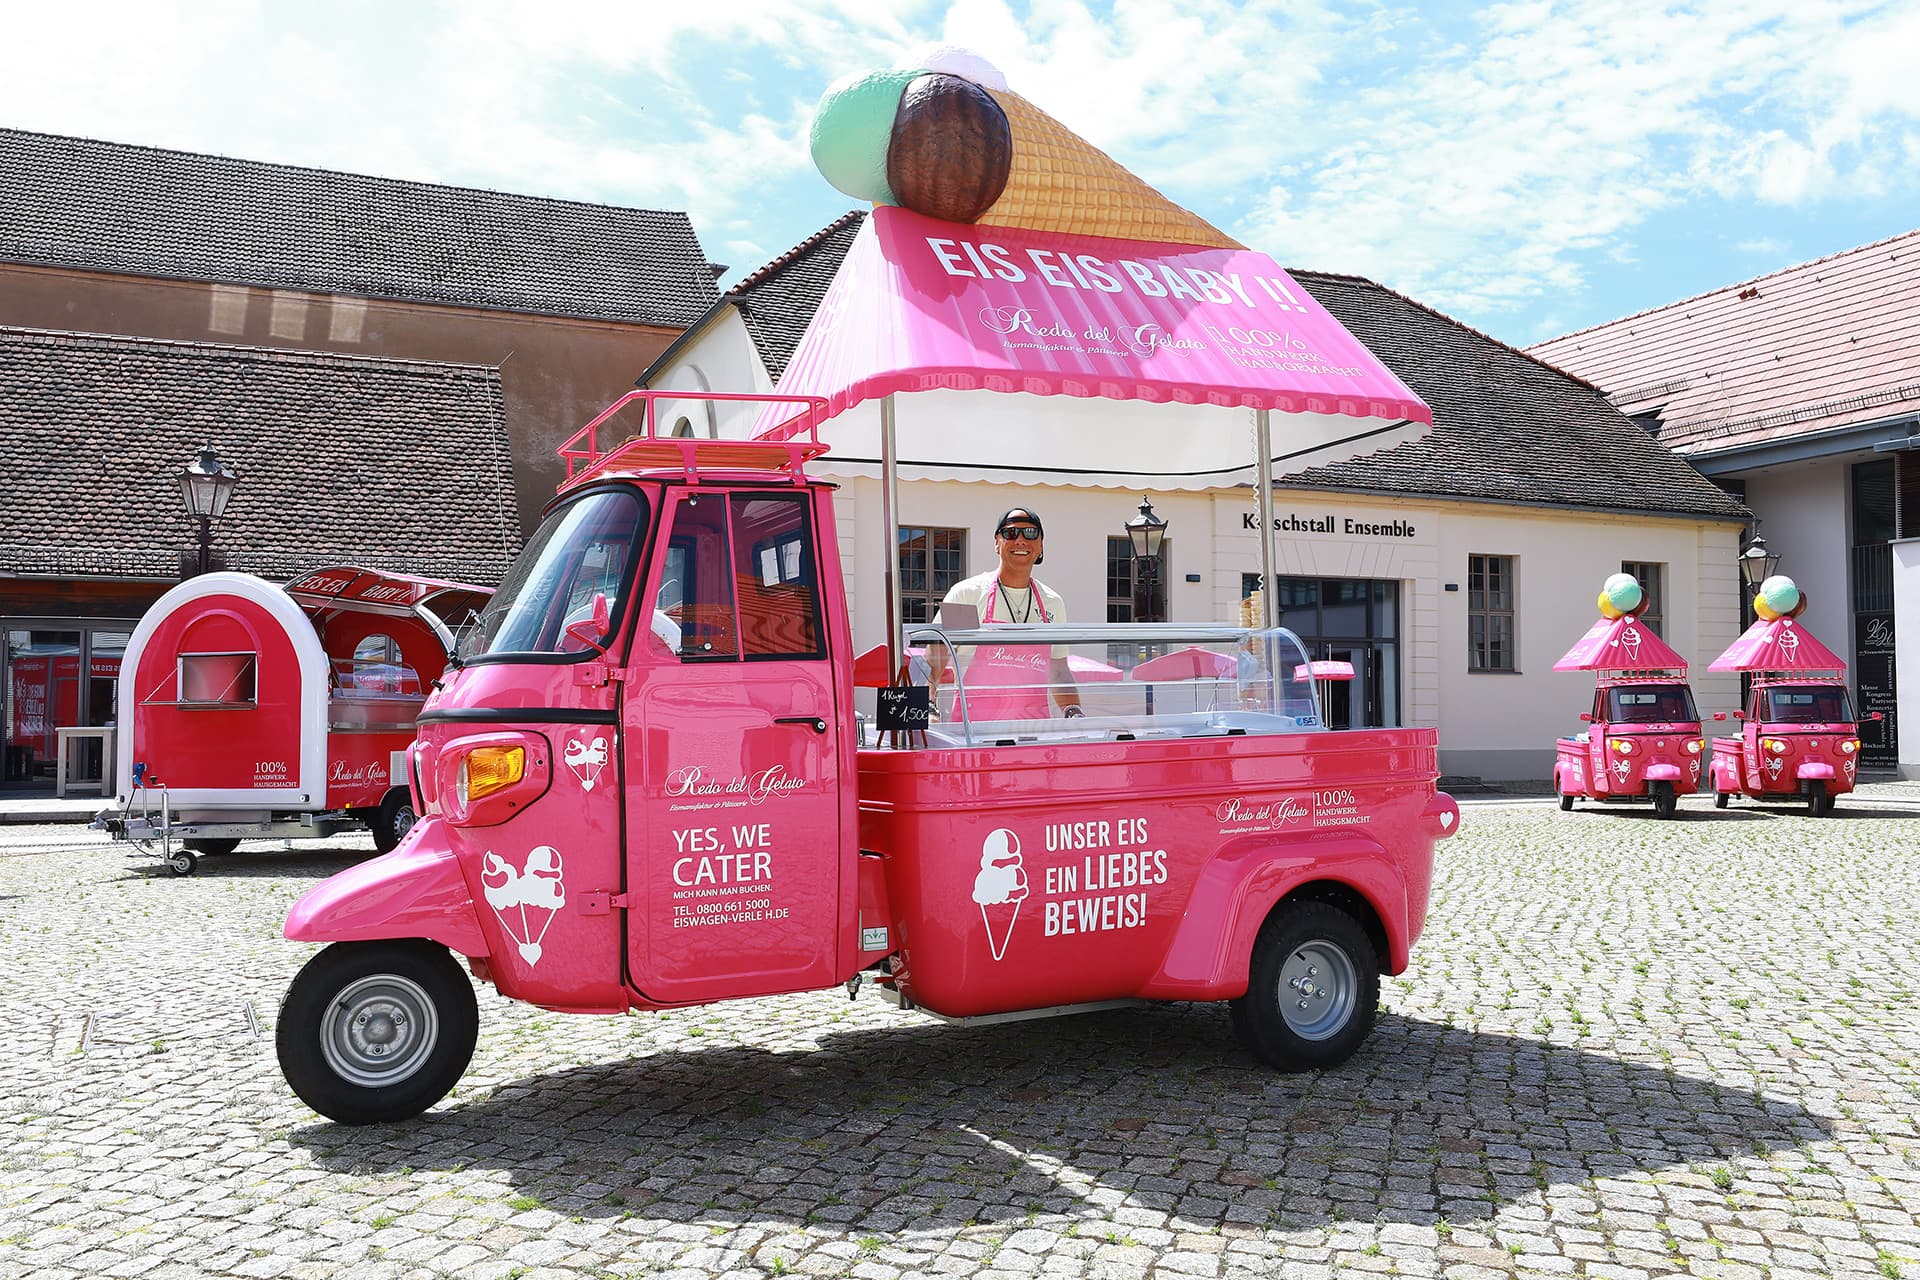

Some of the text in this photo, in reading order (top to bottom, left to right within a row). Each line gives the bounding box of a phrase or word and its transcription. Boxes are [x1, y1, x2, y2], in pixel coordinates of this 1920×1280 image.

[925, 237, 1308, 313] EIS EIS BABY !!
[1083, 323, 1116, 343] del
[1117, 323, 1208, 359] Gelato
[1208, 326, 1307, 350] 100%
[1243, 512, 1415, 537] Kschstall Ensemble
[296, 576, 329, 590] EIS
[321, 579, 348, 593] EIS
[360, 584, 401, 600] BABY
[255, 761, 287, 773] 100%
[725, 776, 748, 793] del
[748, 764, 806, 806] Gelato
[1315, 789, 1355, 806] 100%
[1255, 808, 1270, 820] del
[1270, 796, 1309, 830] Gelato
[672, 824, 771, 853] YES, WE
[1045, 817, 1149, 852] UNSER EIS
[672, 852, 773, 887] CATER
[1045, 849, 1168, 894] EIN LIEBES
[673, 884, 773, 900] MICH KANN MAN BUCHEN.
[673, 899, 770, 916] TEL. 0800 661 5000
[1044, 893, 1147, 937] BEWEIS!
